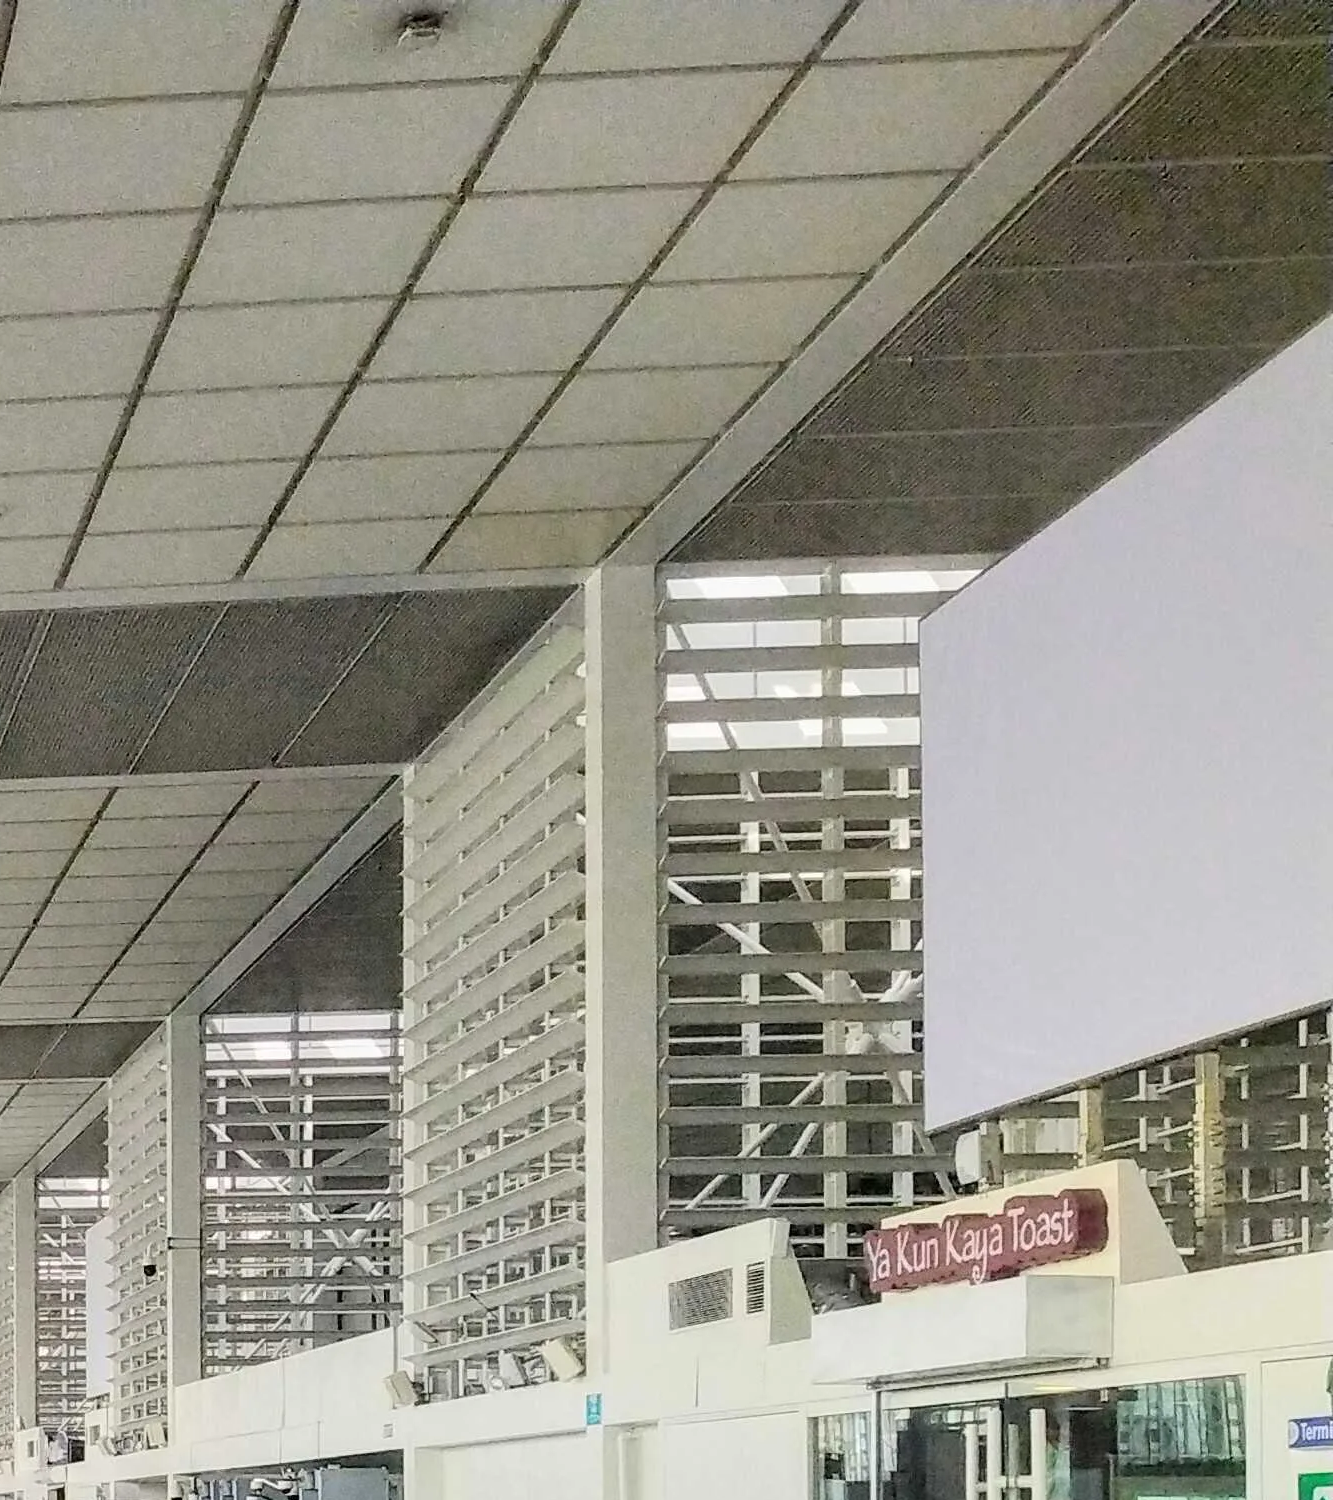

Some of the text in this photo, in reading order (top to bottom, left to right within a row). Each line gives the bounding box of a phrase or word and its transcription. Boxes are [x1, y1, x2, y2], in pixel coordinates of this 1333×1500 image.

[867, 1199, 1074, 1284] Ya Kun Kaya Toast
